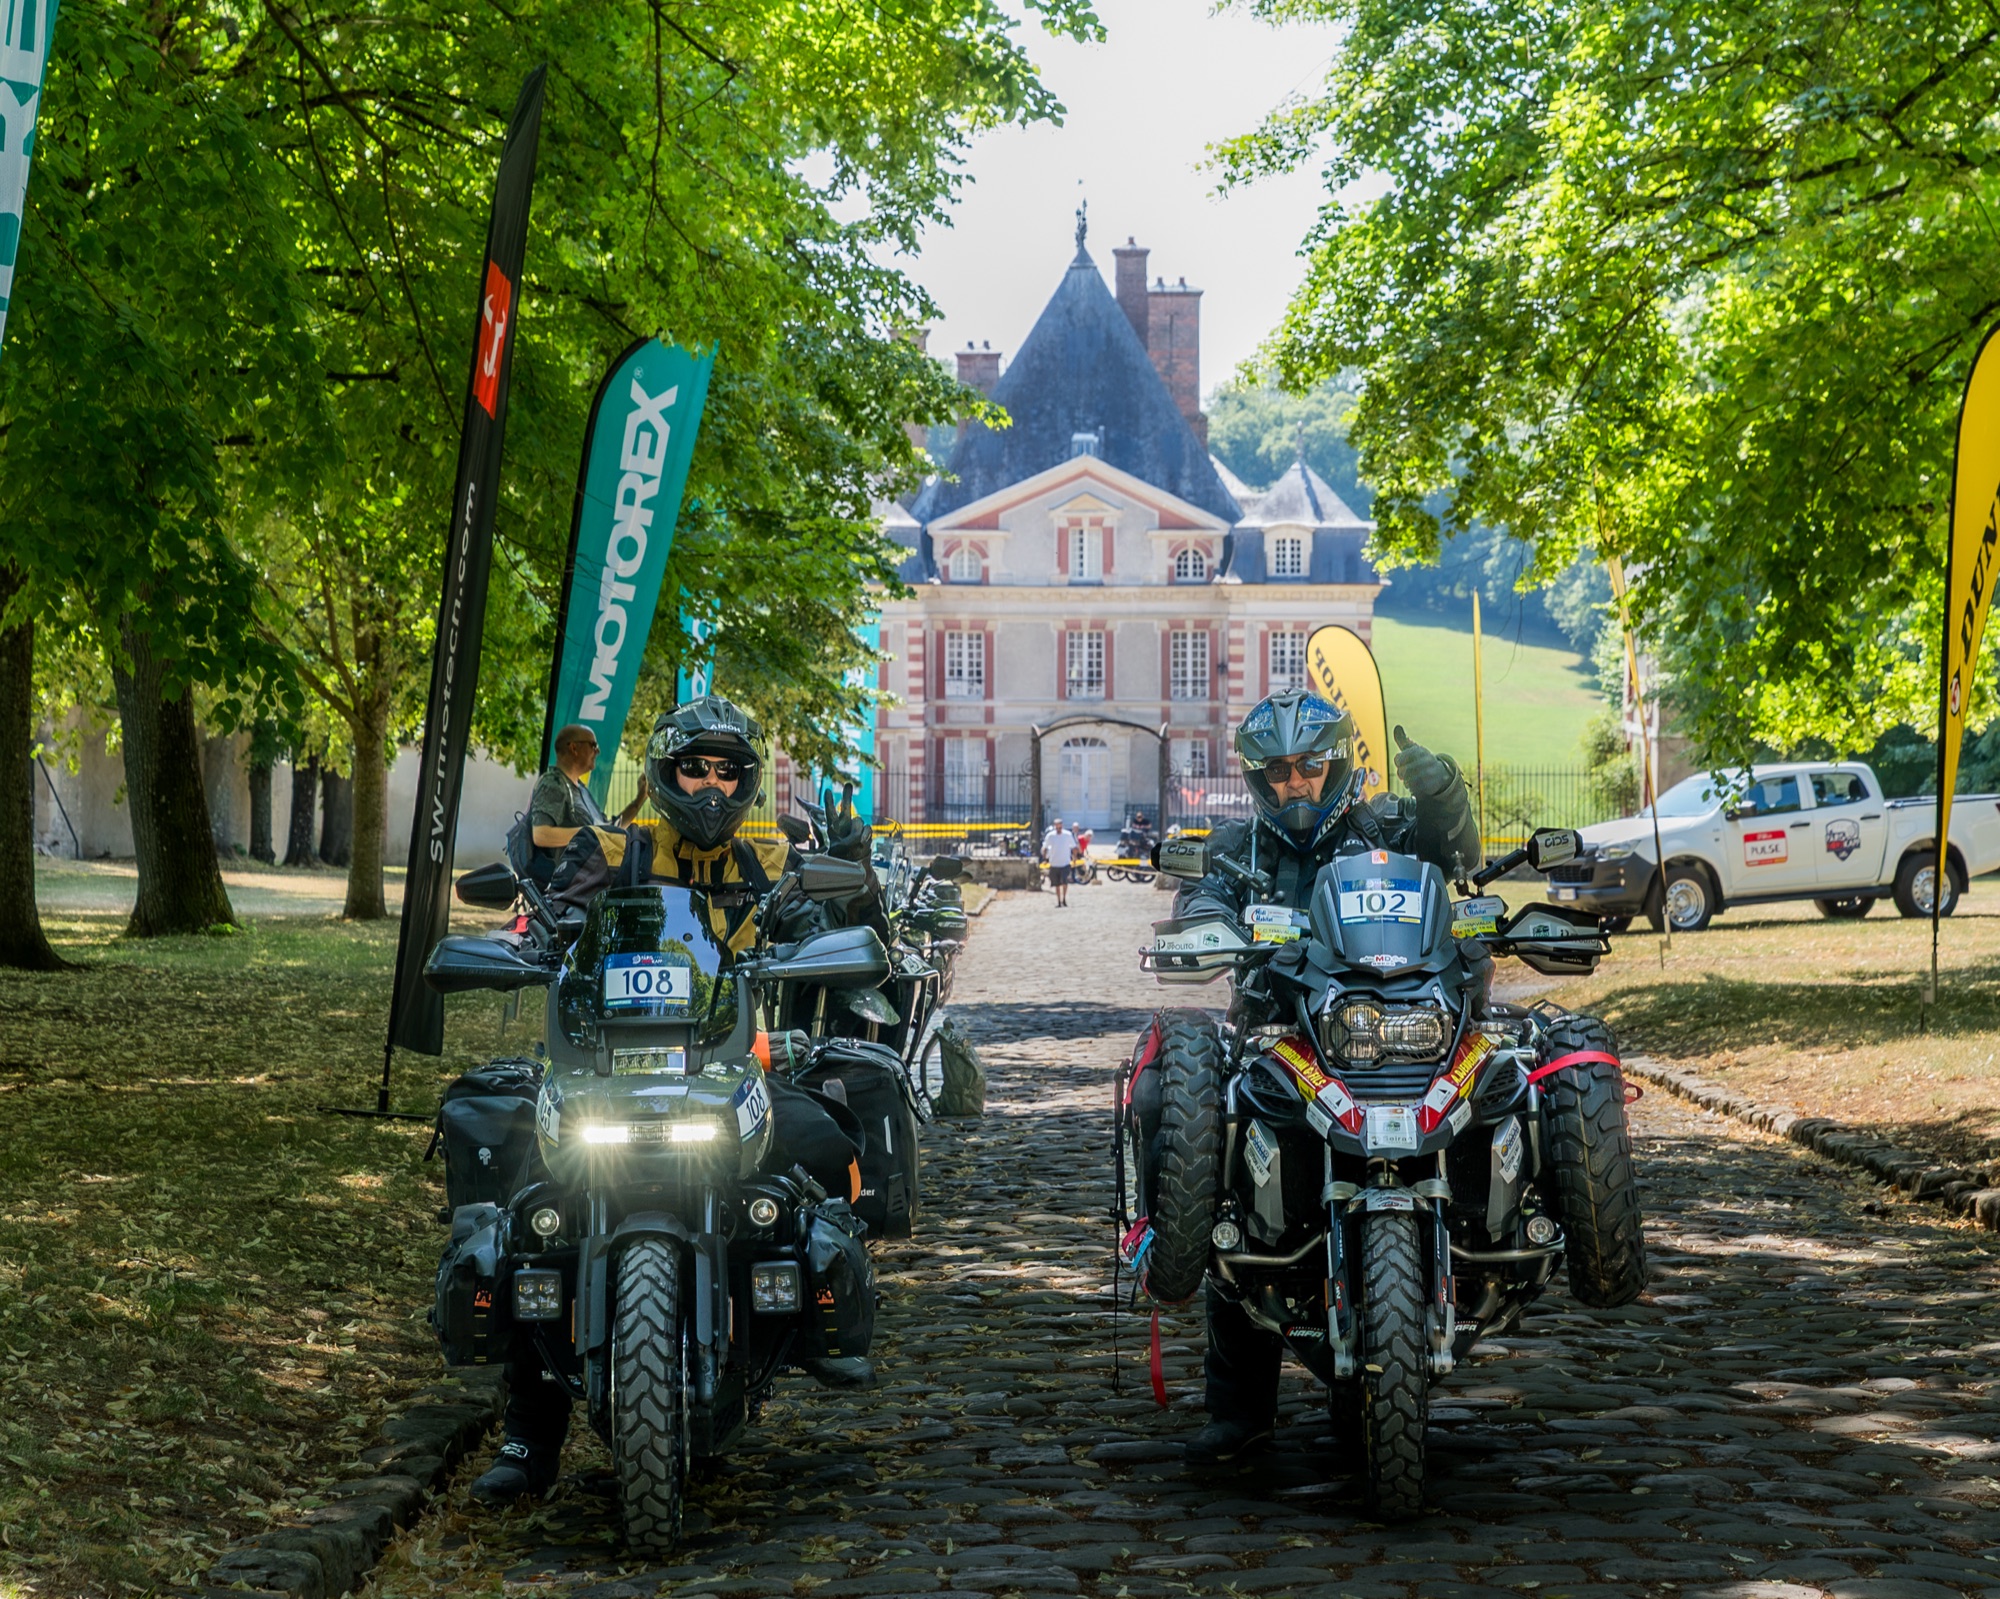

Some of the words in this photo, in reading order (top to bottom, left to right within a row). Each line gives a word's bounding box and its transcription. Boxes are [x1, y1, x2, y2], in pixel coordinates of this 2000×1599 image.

[578, 377, 678, 721] MOTOREX
[1961, 480, 2000, 665] DUN
[1751, 844, 1781, 855] PULSE
[1356, 893, 1406, 914] 102
[622, 969, 673, 995] 108
[1308, 1071, 1327, 1087] FILS
[746, 1086, 765, 1126] 108
[858, 1188, 876, 1196] der
